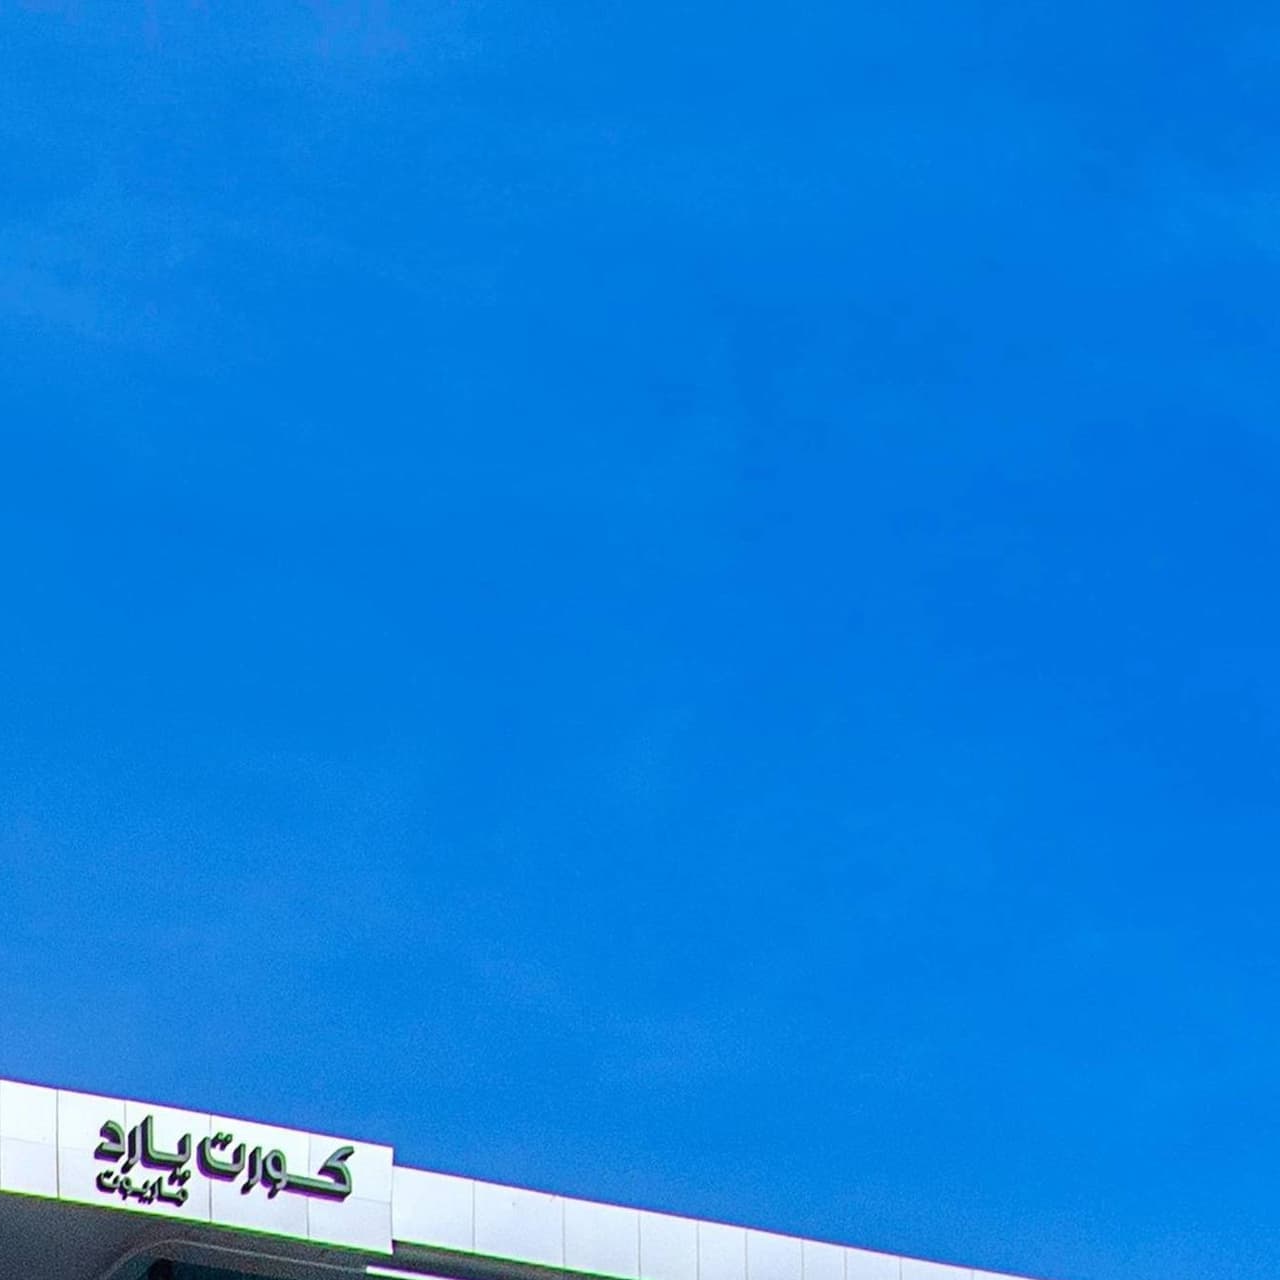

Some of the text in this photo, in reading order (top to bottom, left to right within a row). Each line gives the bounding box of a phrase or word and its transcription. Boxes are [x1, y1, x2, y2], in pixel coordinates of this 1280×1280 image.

[93, 1114, 355, 1203] كورت يارد
[96, 1170, 190, 1208] ماريوت
